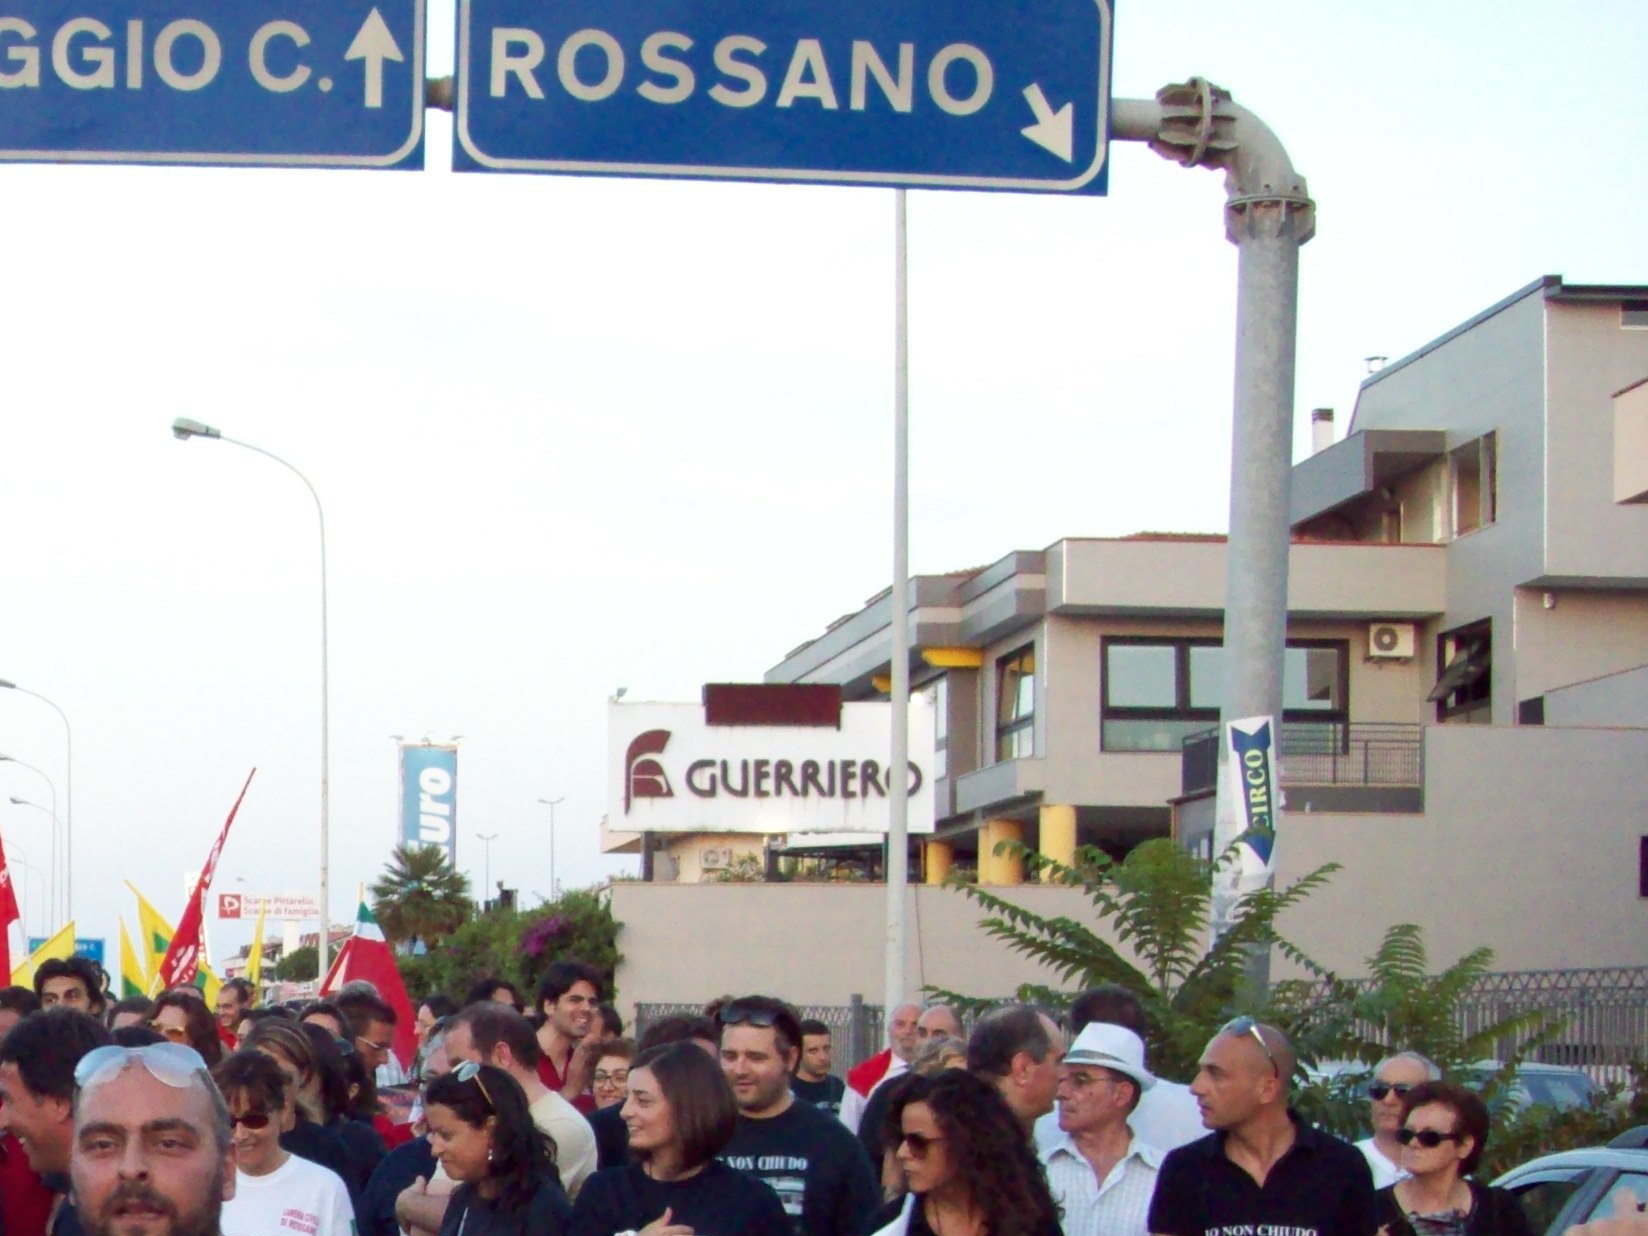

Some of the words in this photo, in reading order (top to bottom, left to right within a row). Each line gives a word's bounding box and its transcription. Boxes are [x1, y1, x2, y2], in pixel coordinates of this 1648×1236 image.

[249, 20, 333, 93] C.
[490, 27, 995, 115] ROSSANO
[685, 758, 923, 799] GUERRIERO
[1222, 1224, 1254, 1236] NON
